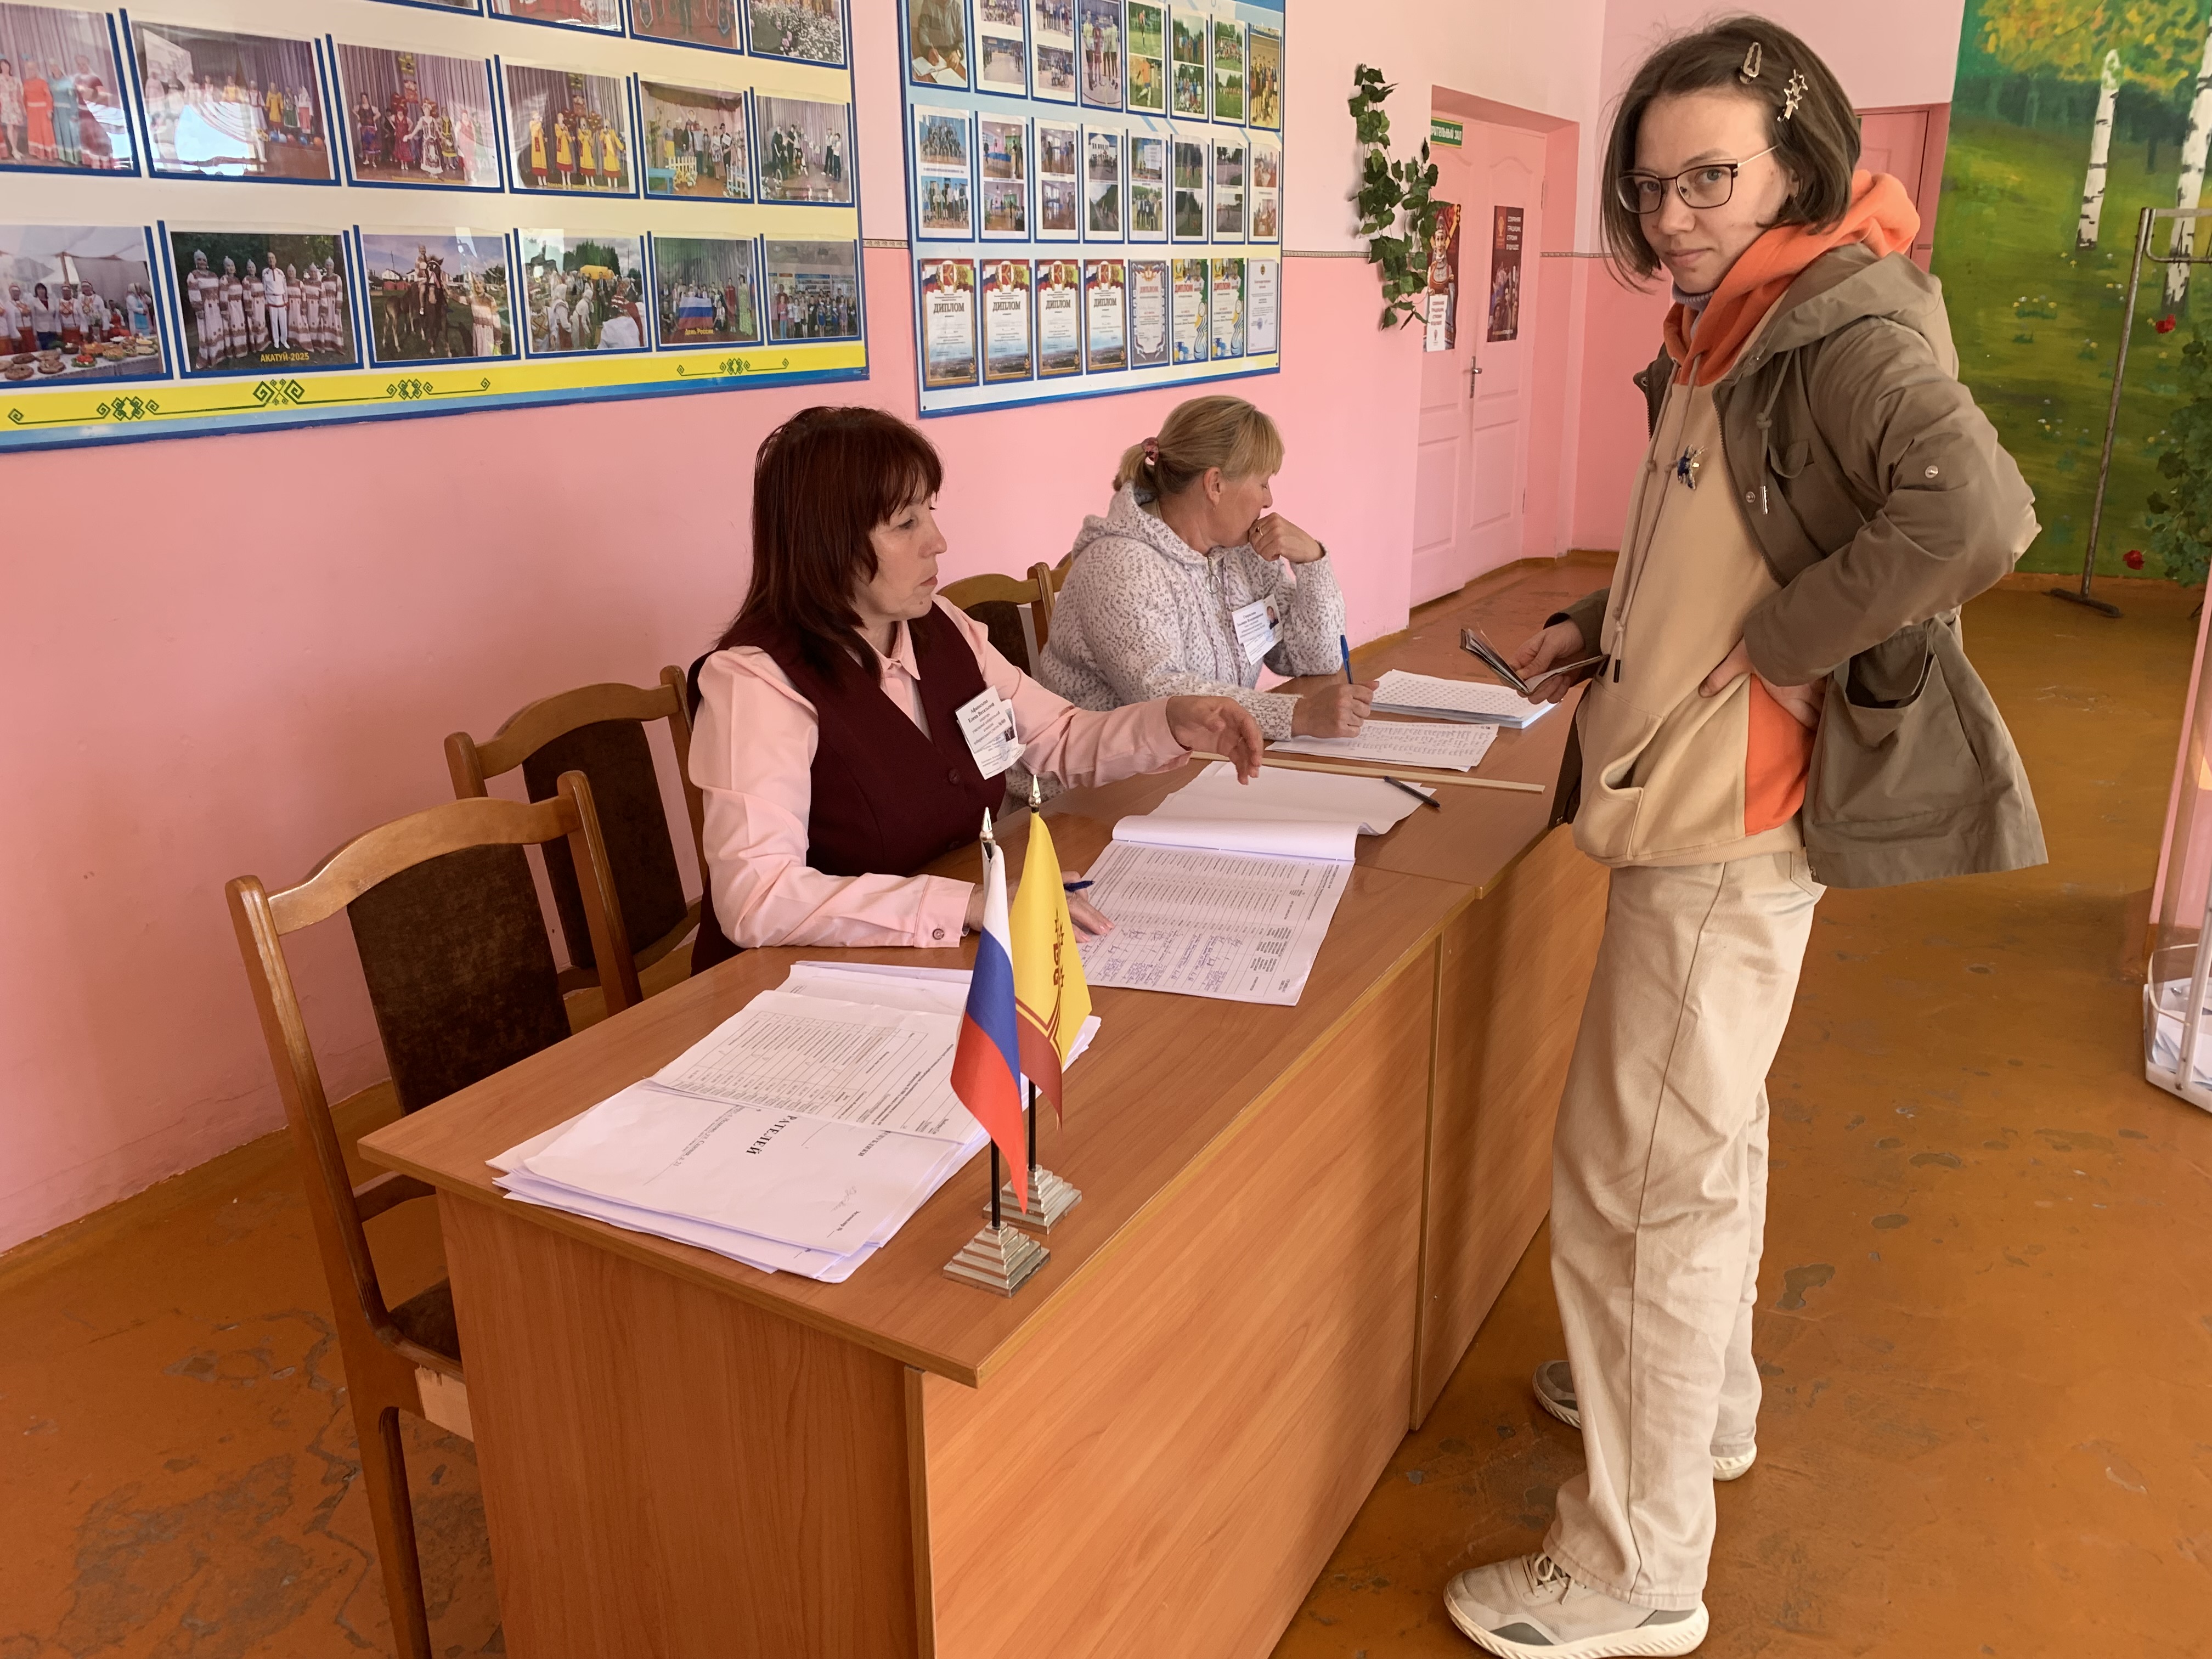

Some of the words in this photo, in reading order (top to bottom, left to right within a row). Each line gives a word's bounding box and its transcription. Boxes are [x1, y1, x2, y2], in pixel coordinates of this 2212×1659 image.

[1431, 126, 1454, 139] РИТЕЛЬНЫЙ
[934, 303, 964, 314] ДИПЛОМ
[993, 301, 1020, 312] ДИПЛОМ
[1046, 300, 1071, 310] ДИПЛОМ
[1094, 298, 1117, 308] ДИПЛОМ
[260, 351, 309, 363] АКАТУЙ-2025
